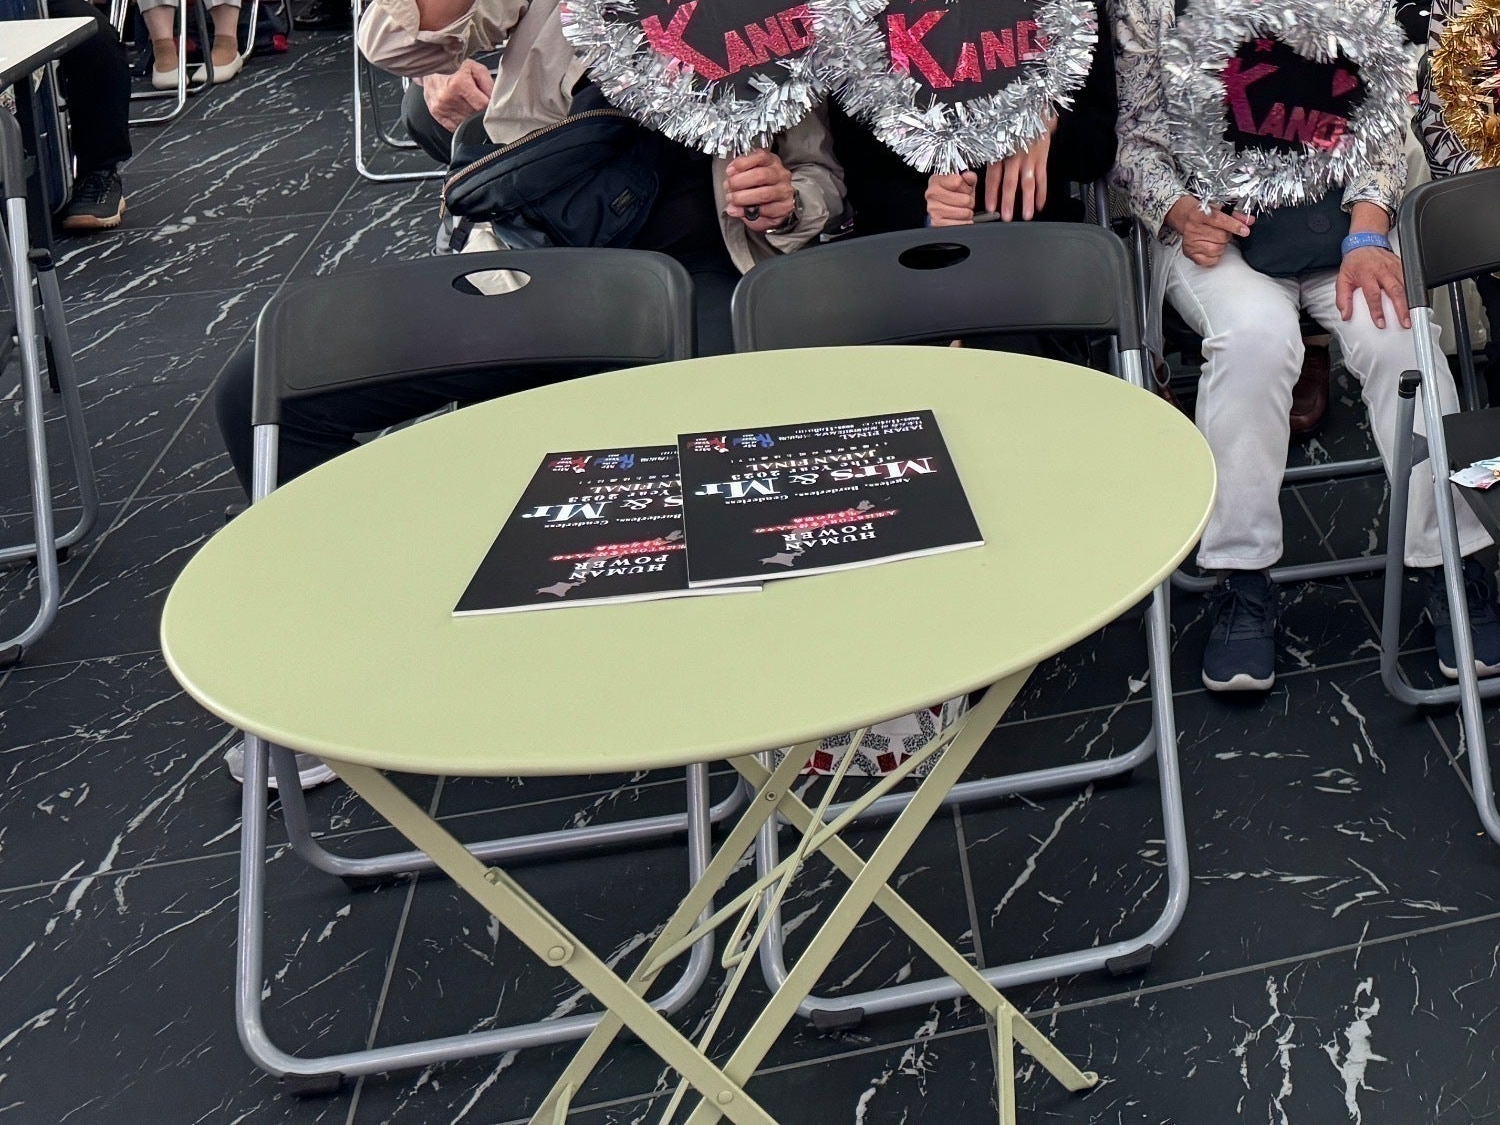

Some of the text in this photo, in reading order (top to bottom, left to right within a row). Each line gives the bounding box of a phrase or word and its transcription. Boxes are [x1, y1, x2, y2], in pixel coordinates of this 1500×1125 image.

[745, 457, 817, 472] FINAL
[820, 450, 878, 466] JAPAN
[730, 469, 781, 481] 2023
[788, 463, 833, 475] Year
[830, 456, 938, 481] Mrs
[789, 473, 817, 485] &
[590, 482, 651, 493] FINAL
[694, 477, 782, 499] Mr
[568, 493, 620, 503] 2023
[620, 499, 653, 511] &
[724, 492, 789, 505] Genderless
[522, 502, 613, 523] Mr
[783, 522, 874, 542] POWER
[785, 531, 876, 551] HUMAN
[575, 554, 670, 570] POWER
[569, 563, 665, 580] HUMAN
